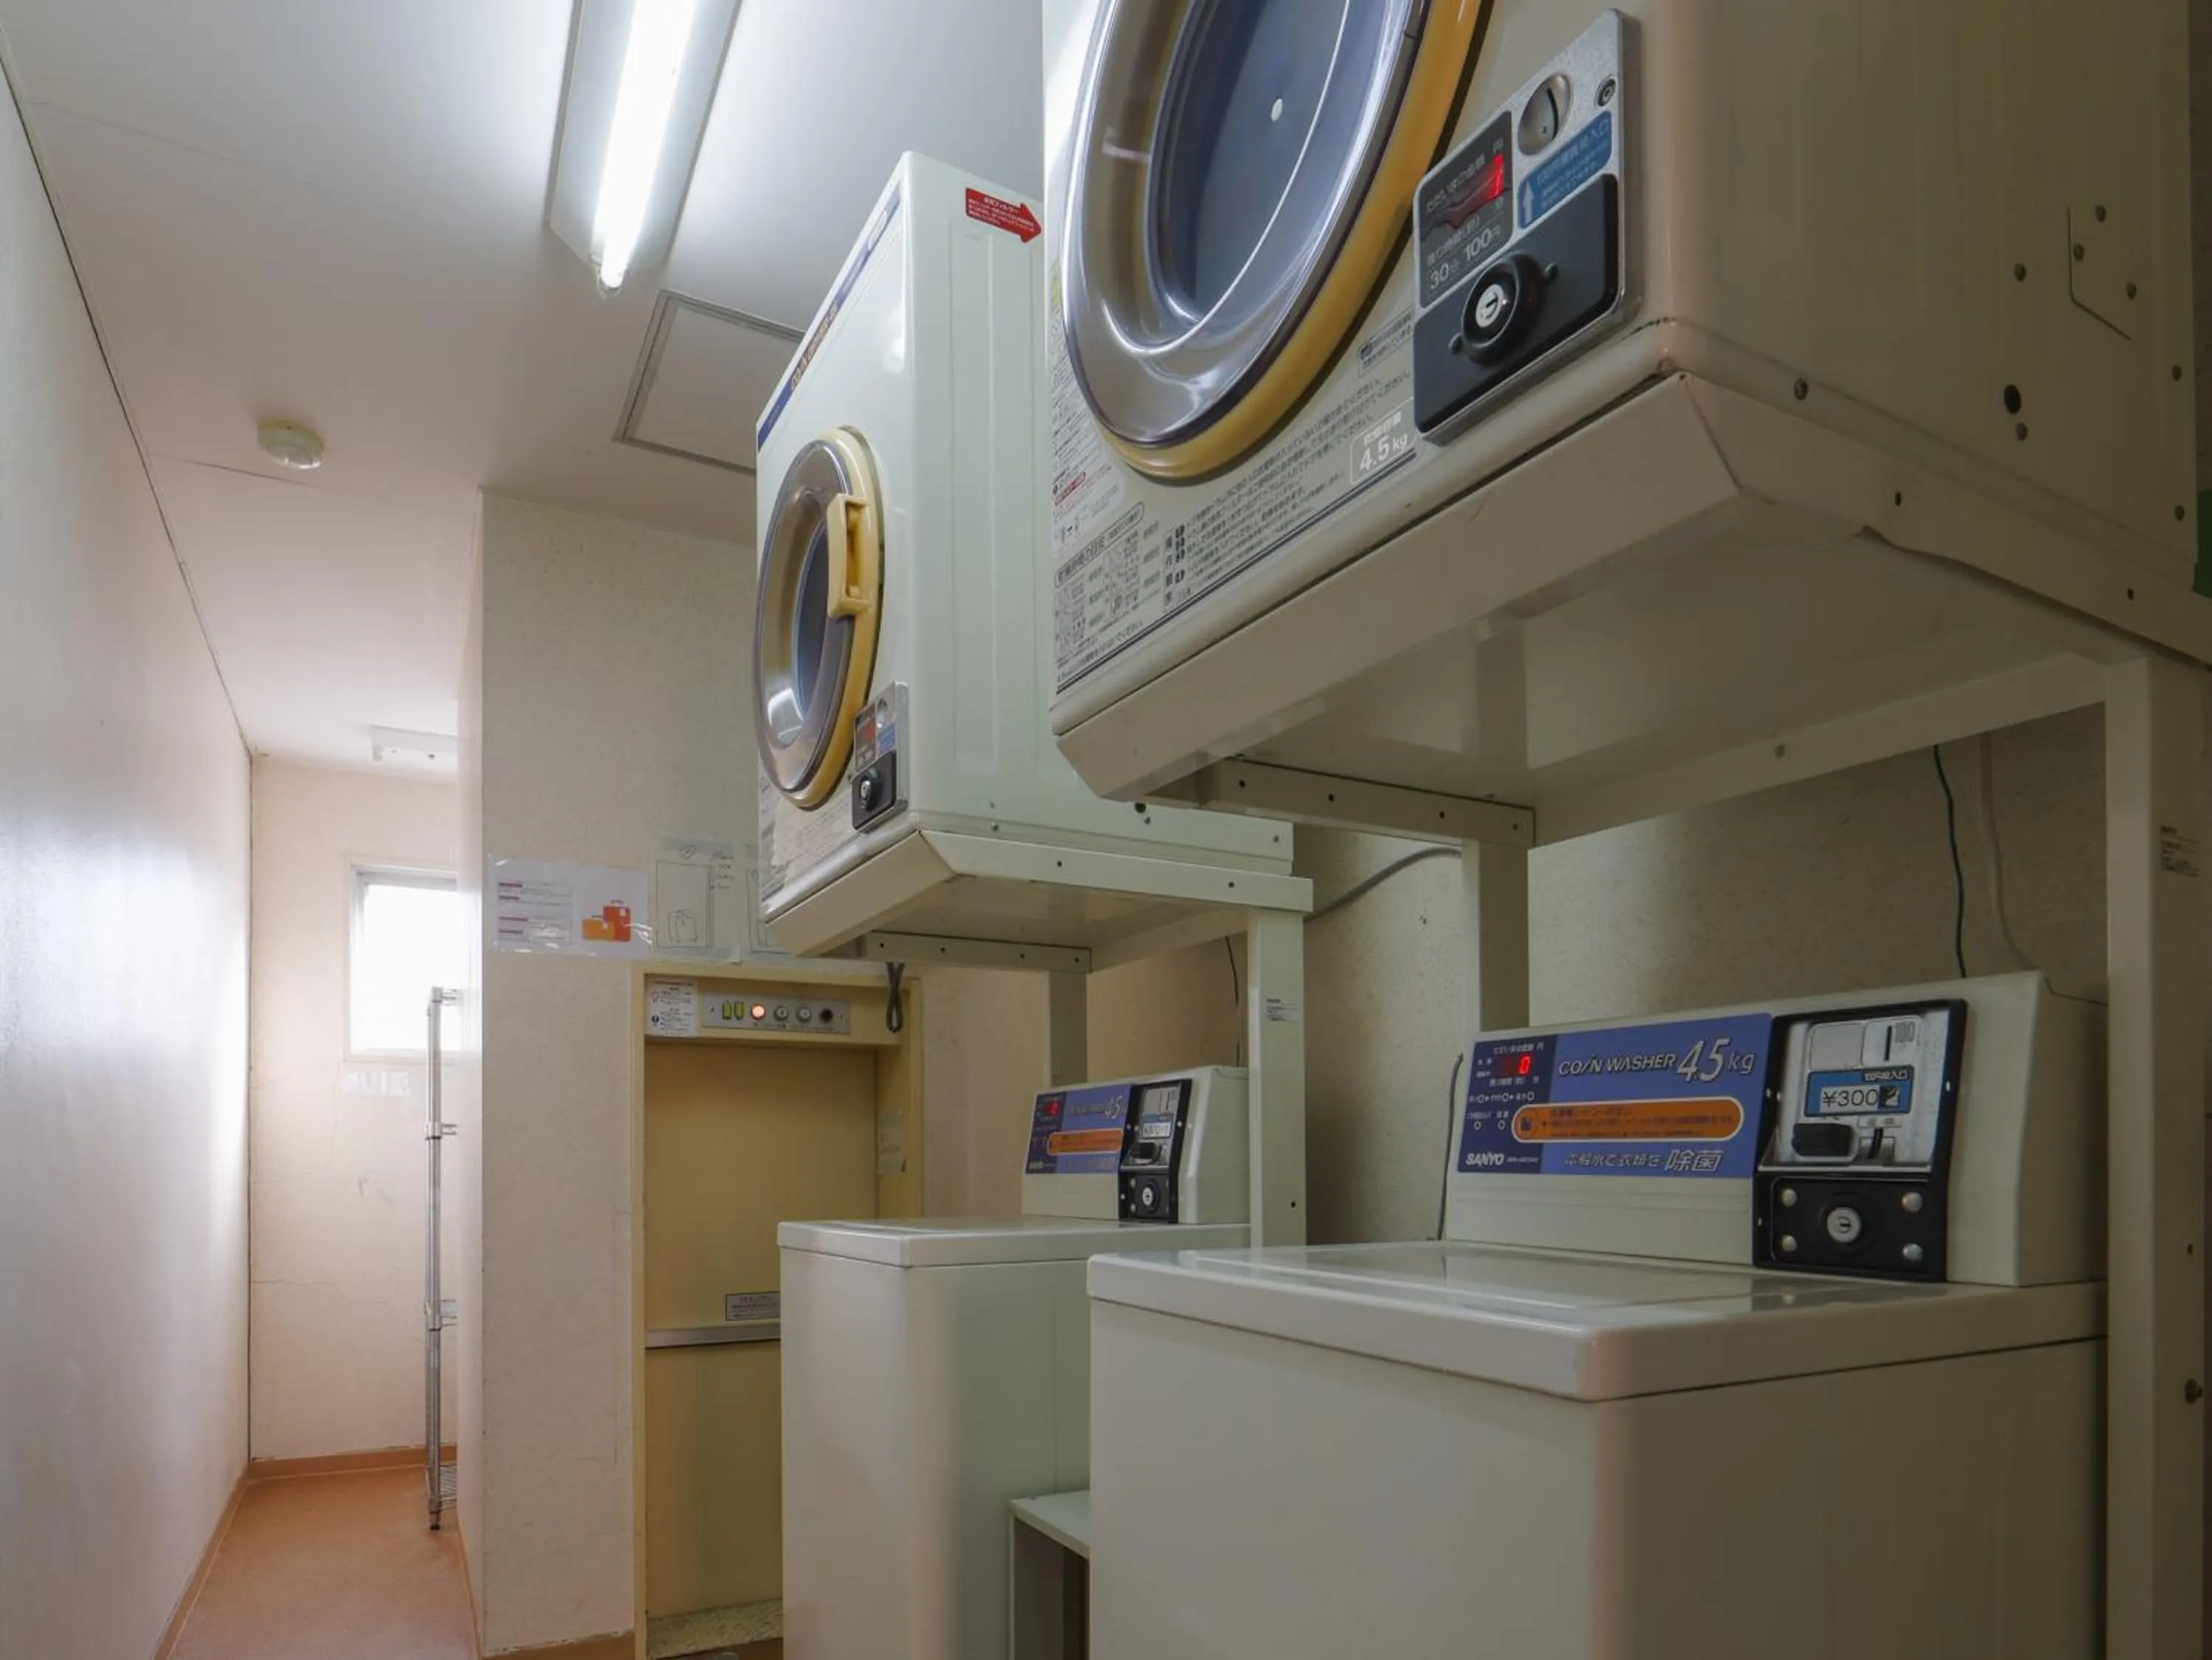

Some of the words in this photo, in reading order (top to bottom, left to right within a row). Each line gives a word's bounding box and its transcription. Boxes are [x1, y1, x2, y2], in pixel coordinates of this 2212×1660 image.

[1519, 1056, 1531, 1075] 0
[1607, 1053, 1677, 1073] WASHER
[1821, 1088, 1878, 1108] ¥300
[1465, 1152, 1505, 1166] SANYO
[1663, 1150, 1724, 1172] 除菌
